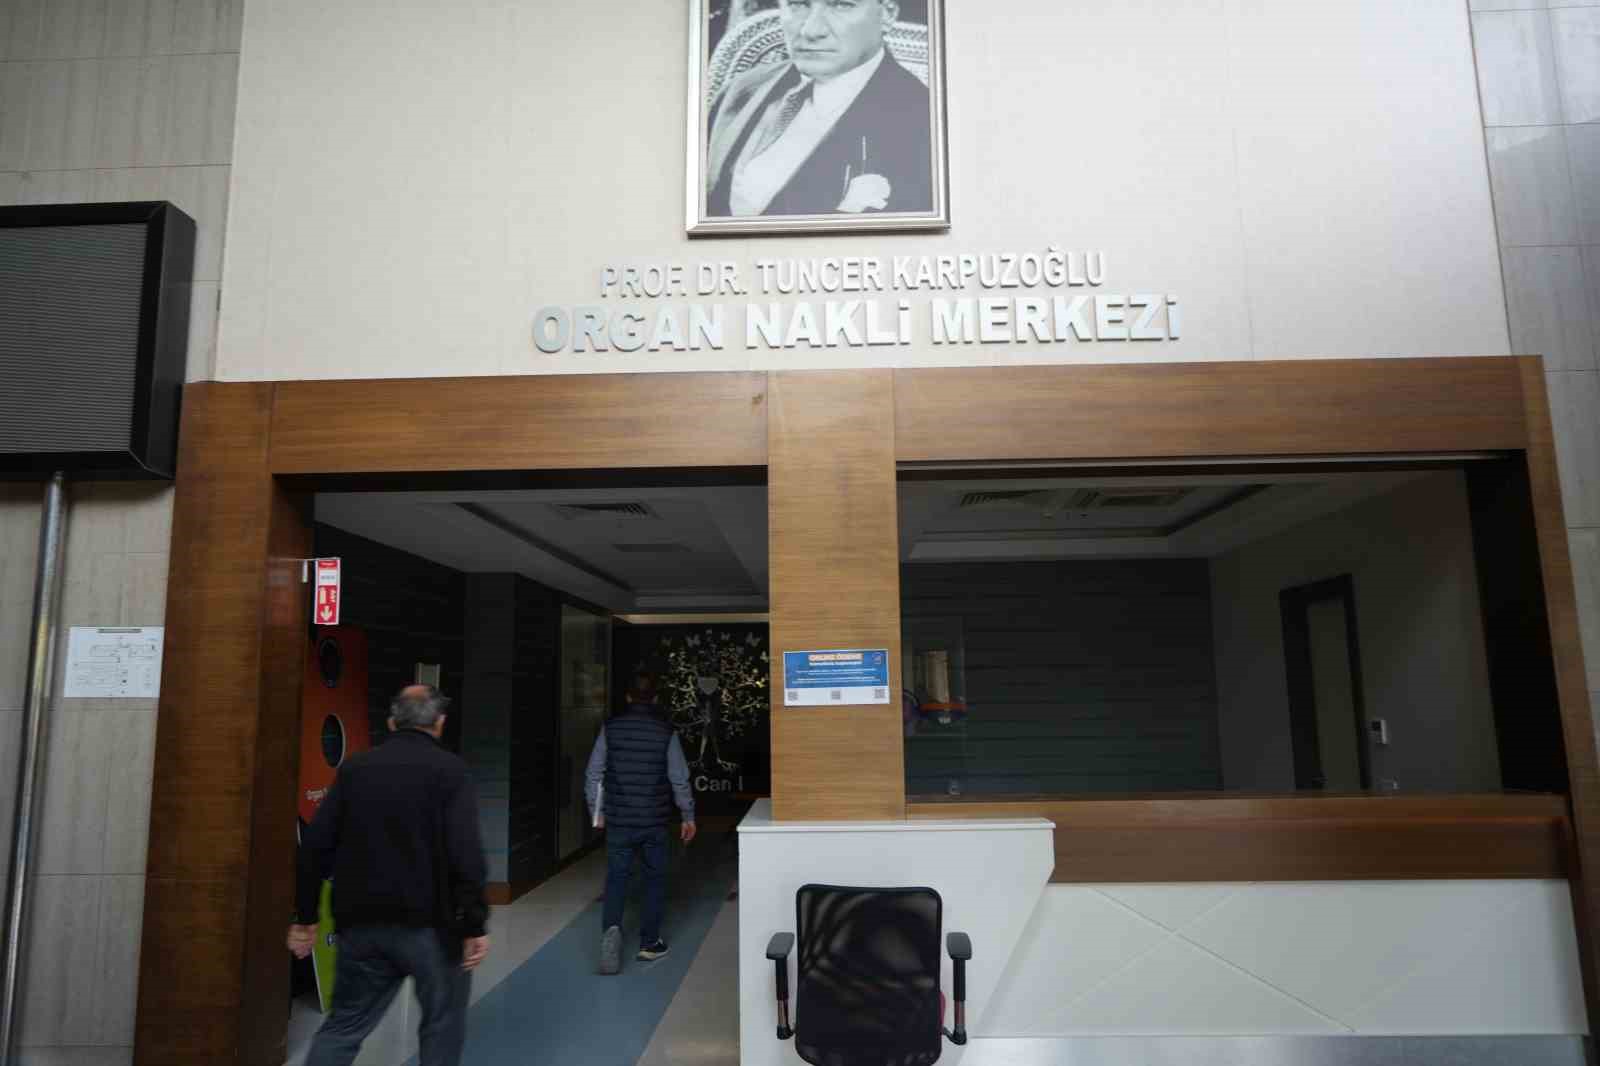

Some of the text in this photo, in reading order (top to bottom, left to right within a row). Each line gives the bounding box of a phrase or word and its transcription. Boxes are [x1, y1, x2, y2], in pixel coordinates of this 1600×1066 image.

[600, 245, 1106, 298] PROF. DR. TUNCER KARPUZOĞLU
[532, 303, 724, 353] ORGAN
[695, 775, 732, 792] Can
